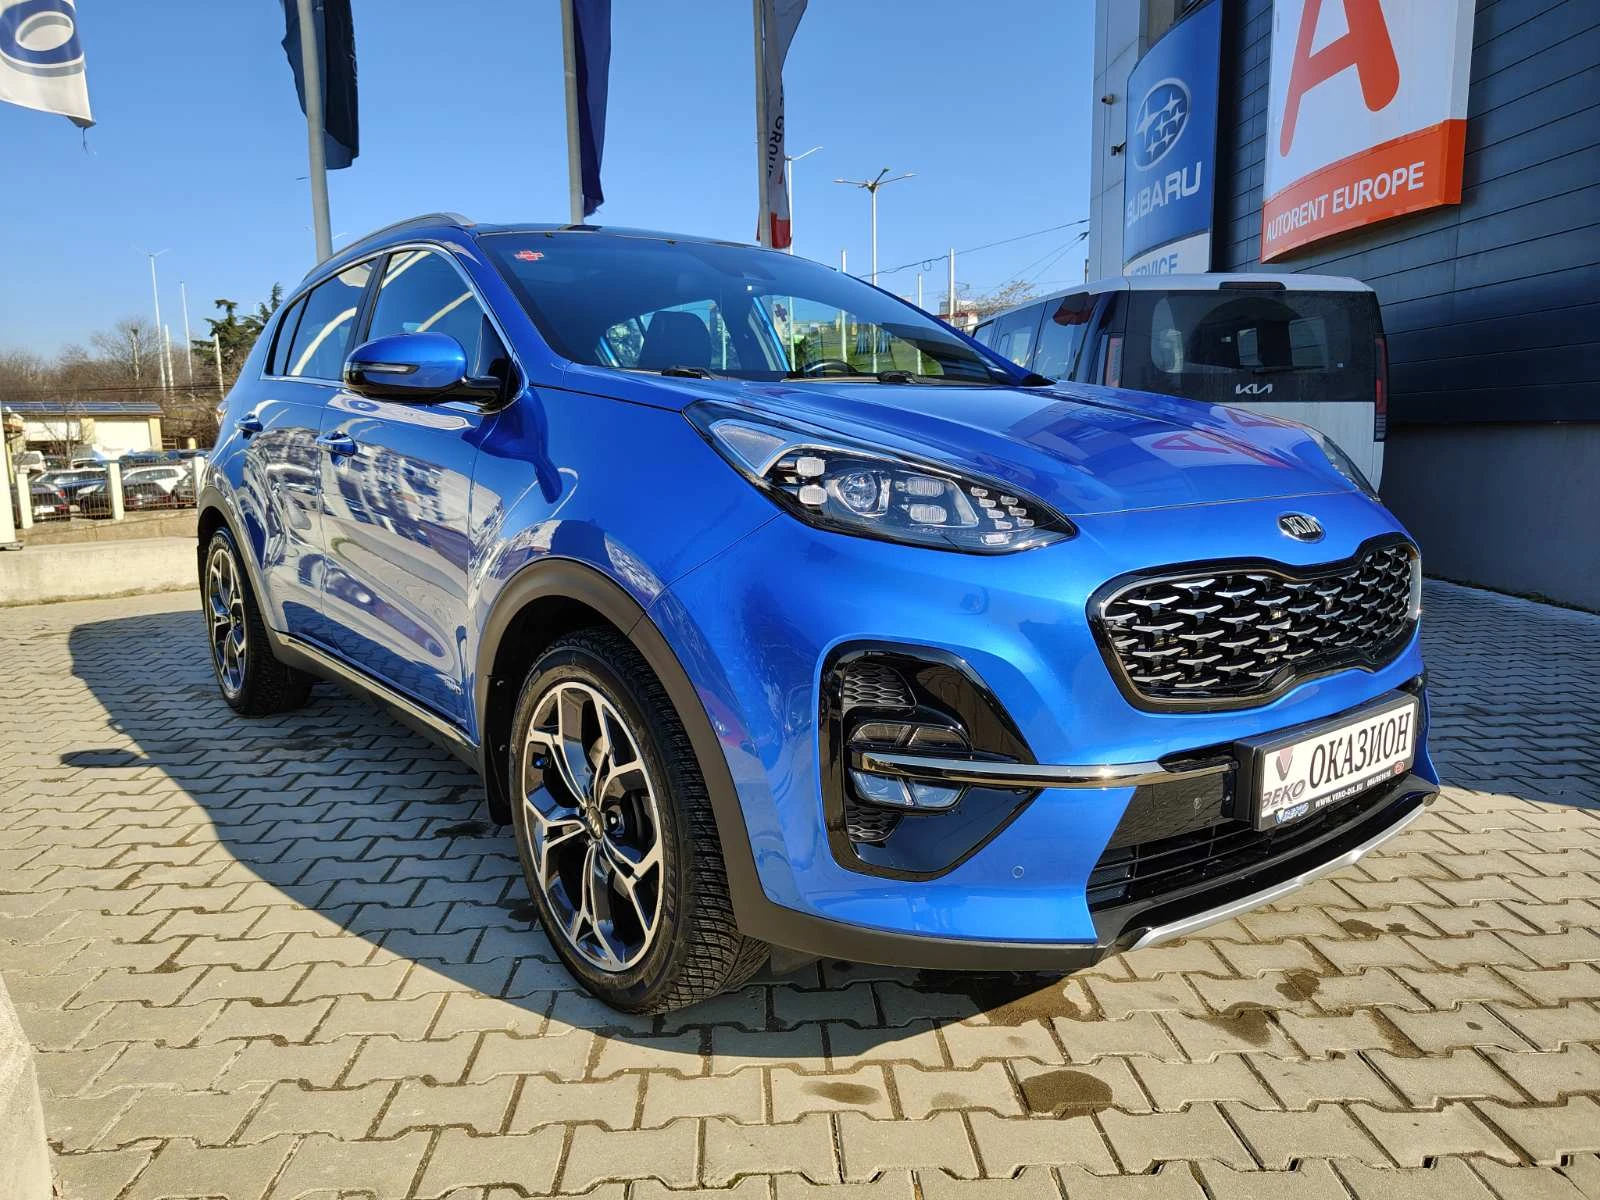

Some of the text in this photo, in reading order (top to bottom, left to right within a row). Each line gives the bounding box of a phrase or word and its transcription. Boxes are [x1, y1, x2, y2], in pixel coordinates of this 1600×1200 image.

[1127, 161, 1202, 228] SUBARU
[1266, 161, 1424, 243] AUTORENT EUROPE
[1235, 383, 1273, 394] KIA
[1281, 514, 1322, 537] KIA
[1309, 711, 1411, 789] ОКАЗИОН
